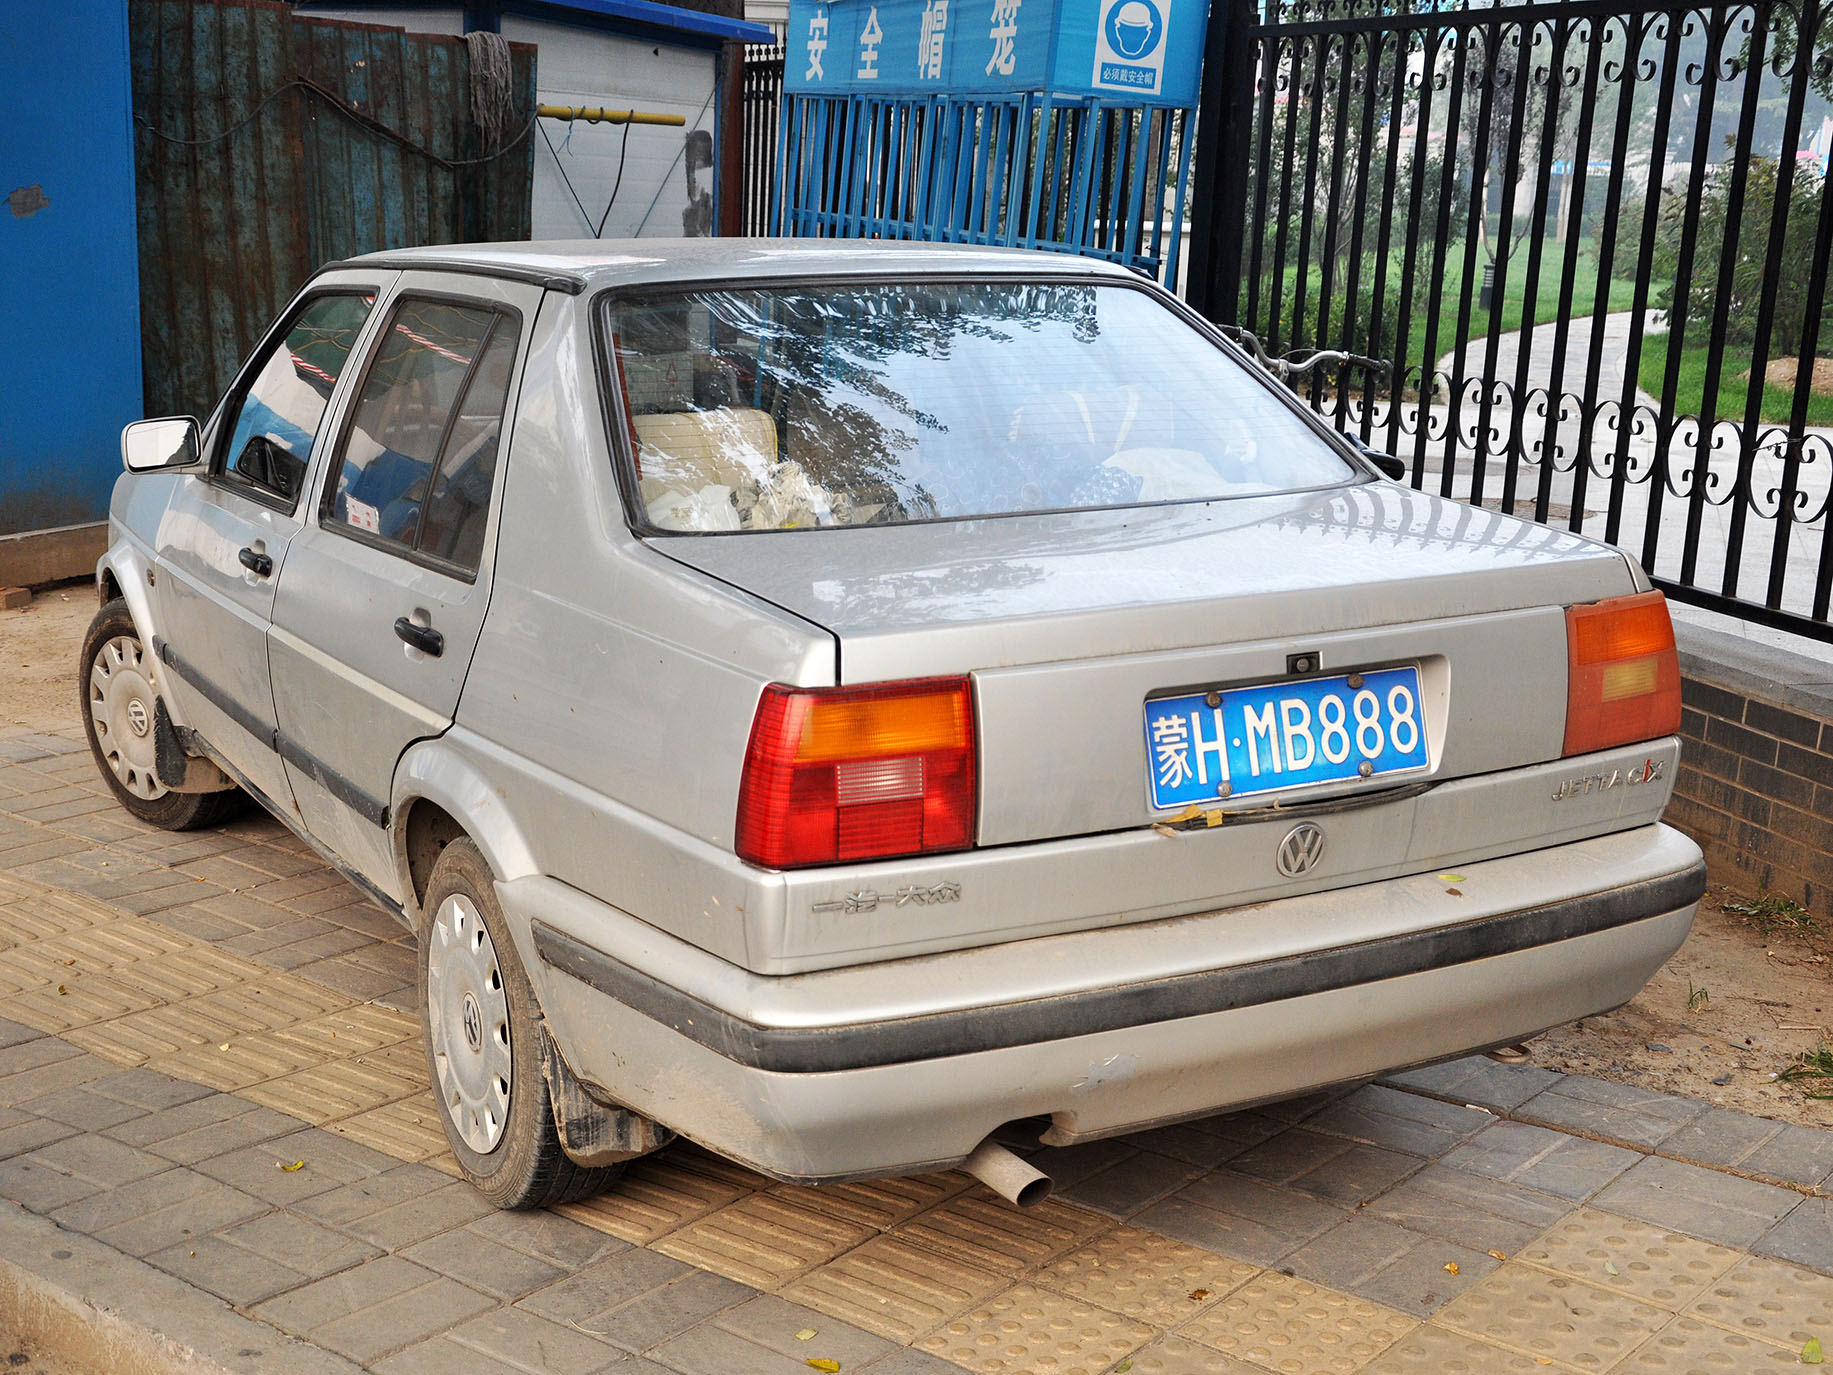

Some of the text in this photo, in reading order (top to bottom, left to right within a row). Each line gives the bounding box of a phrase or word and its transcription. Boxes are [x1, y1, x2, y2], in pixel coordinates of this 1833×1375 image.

[804, 0, 1022, 82] 安全帽笼
[1102, 67, 1154, 86] 必须戴安全帽
[1551, 769, 1622, 801] JETTA
